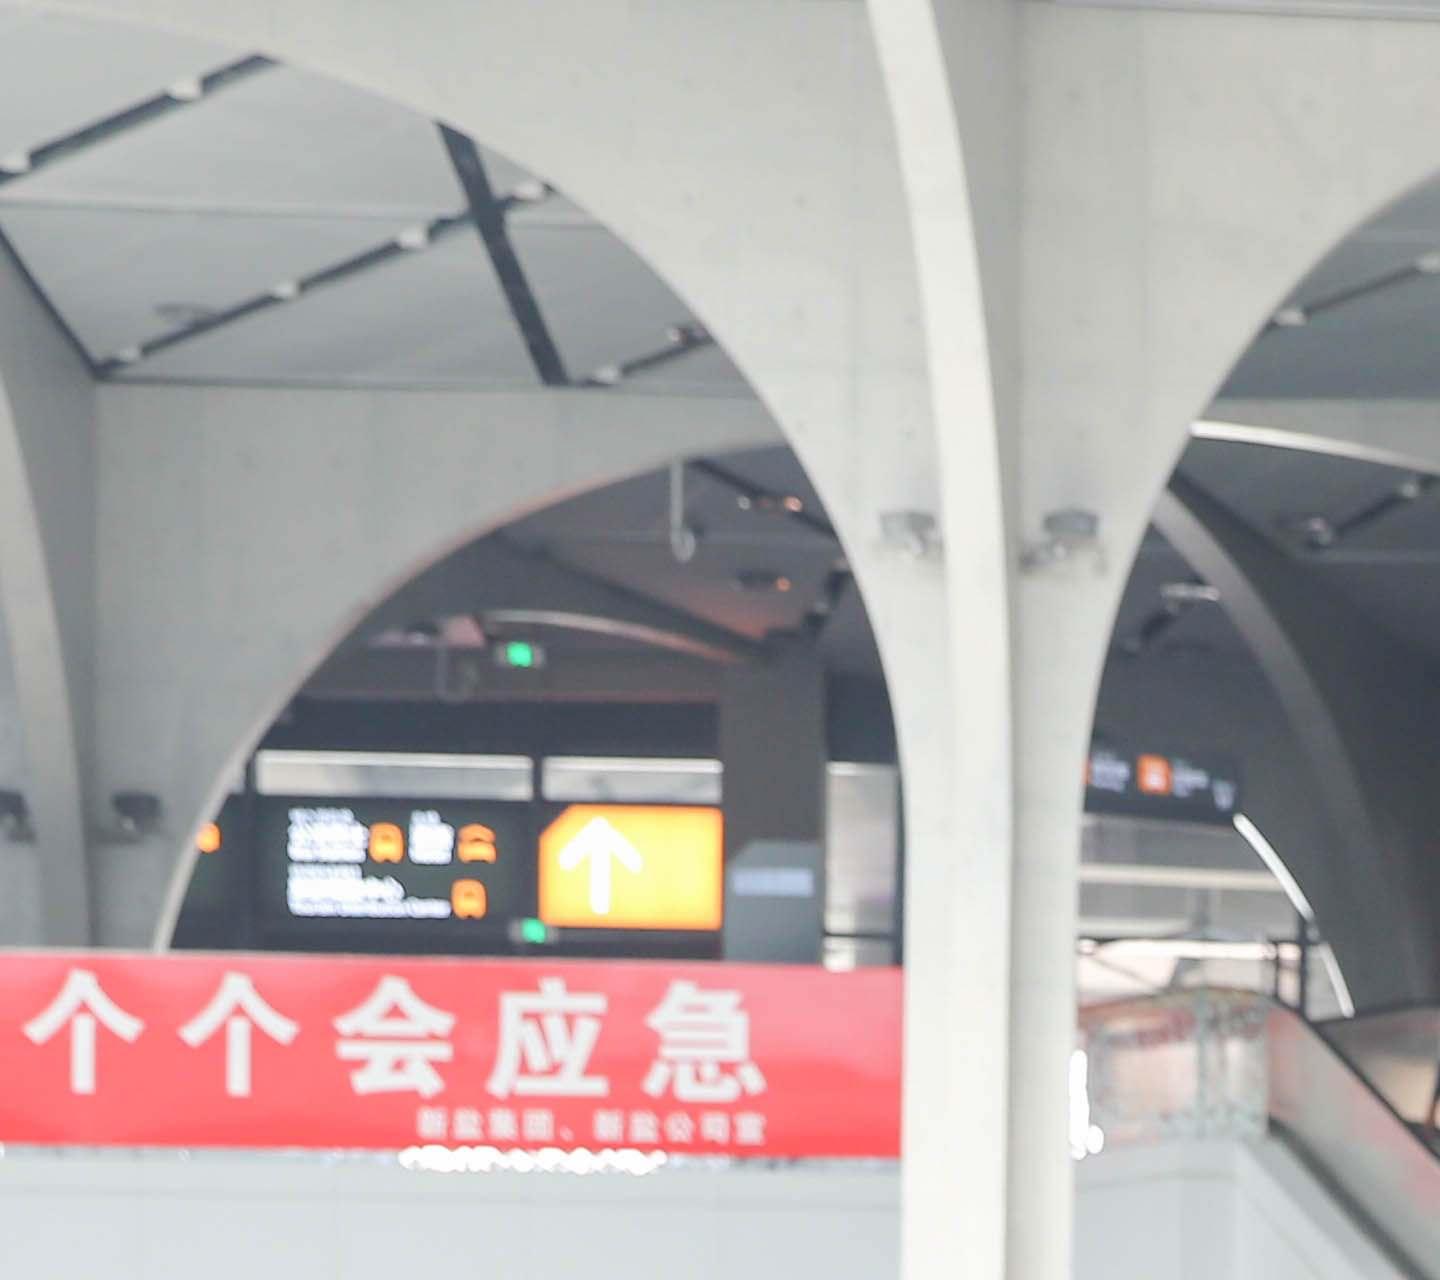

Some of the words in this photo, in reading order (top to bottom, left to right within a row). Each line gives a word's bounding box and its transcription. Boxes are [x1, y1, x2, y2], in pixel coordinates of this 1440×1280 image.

[23, 966, 769, 1103] 个个会应急
